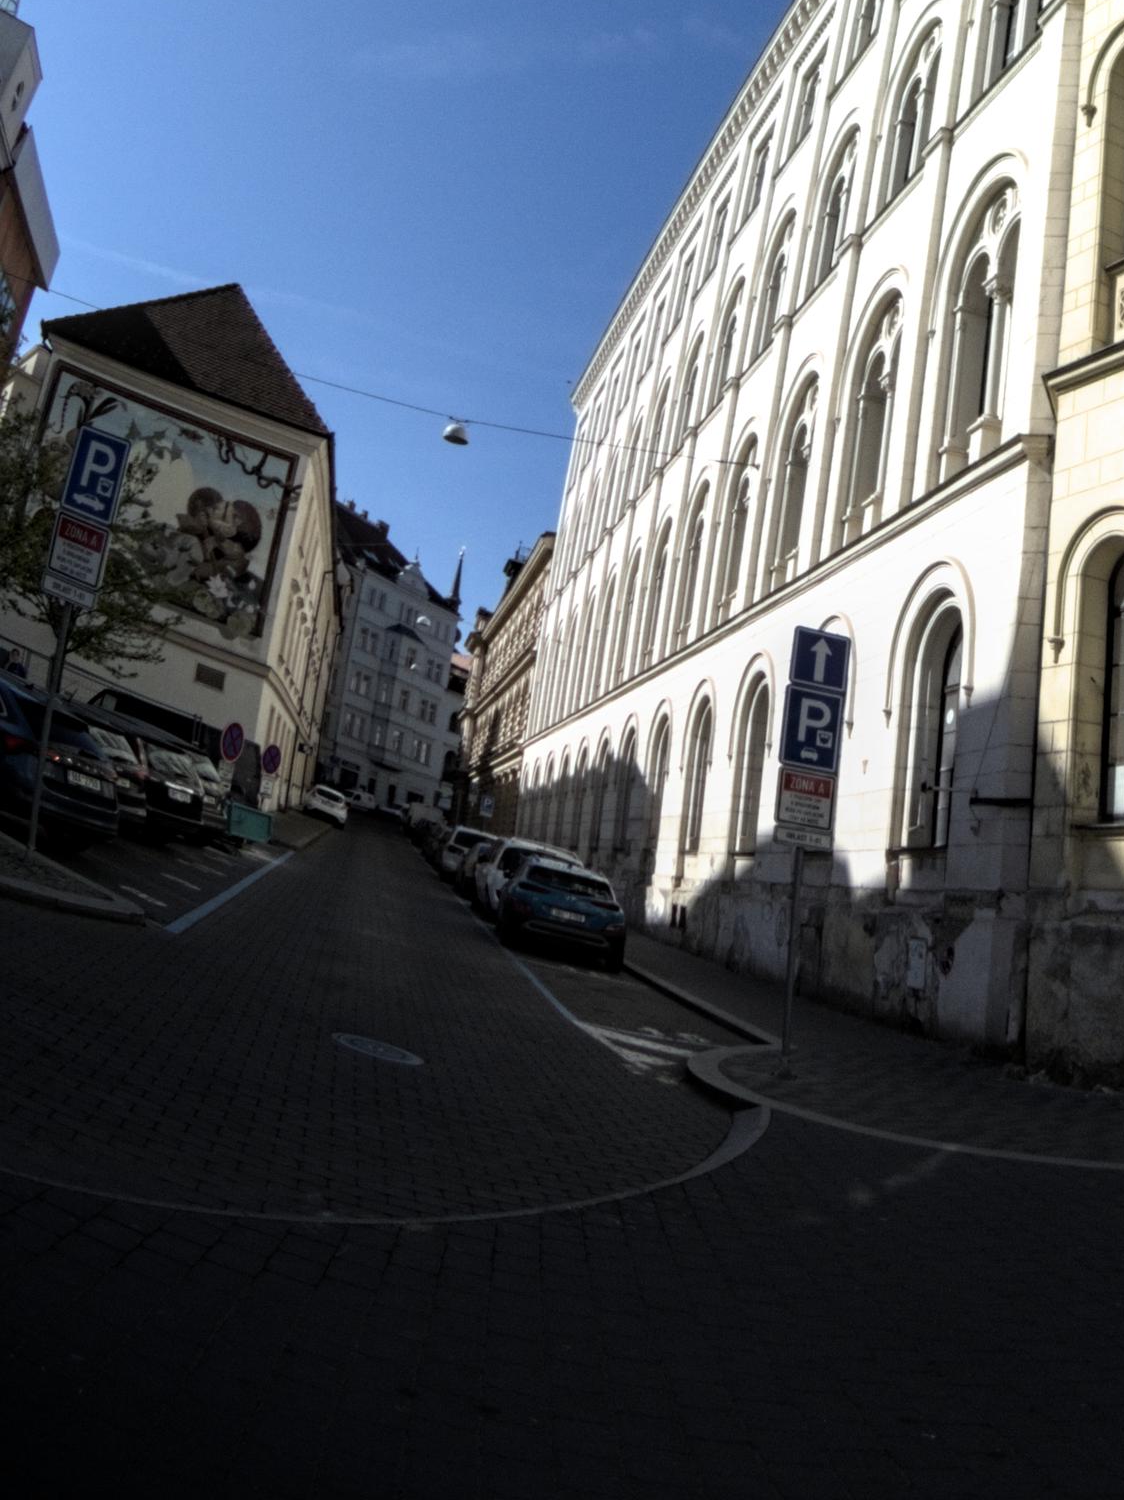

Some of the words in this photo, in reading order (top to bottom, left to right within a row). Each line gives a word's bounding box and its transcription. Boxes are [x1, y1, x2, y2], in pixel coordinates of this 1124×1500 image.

[80, 440, 116, 486] P
[798, 698, 831, 742] P
[817, 783, 826, 795] A
